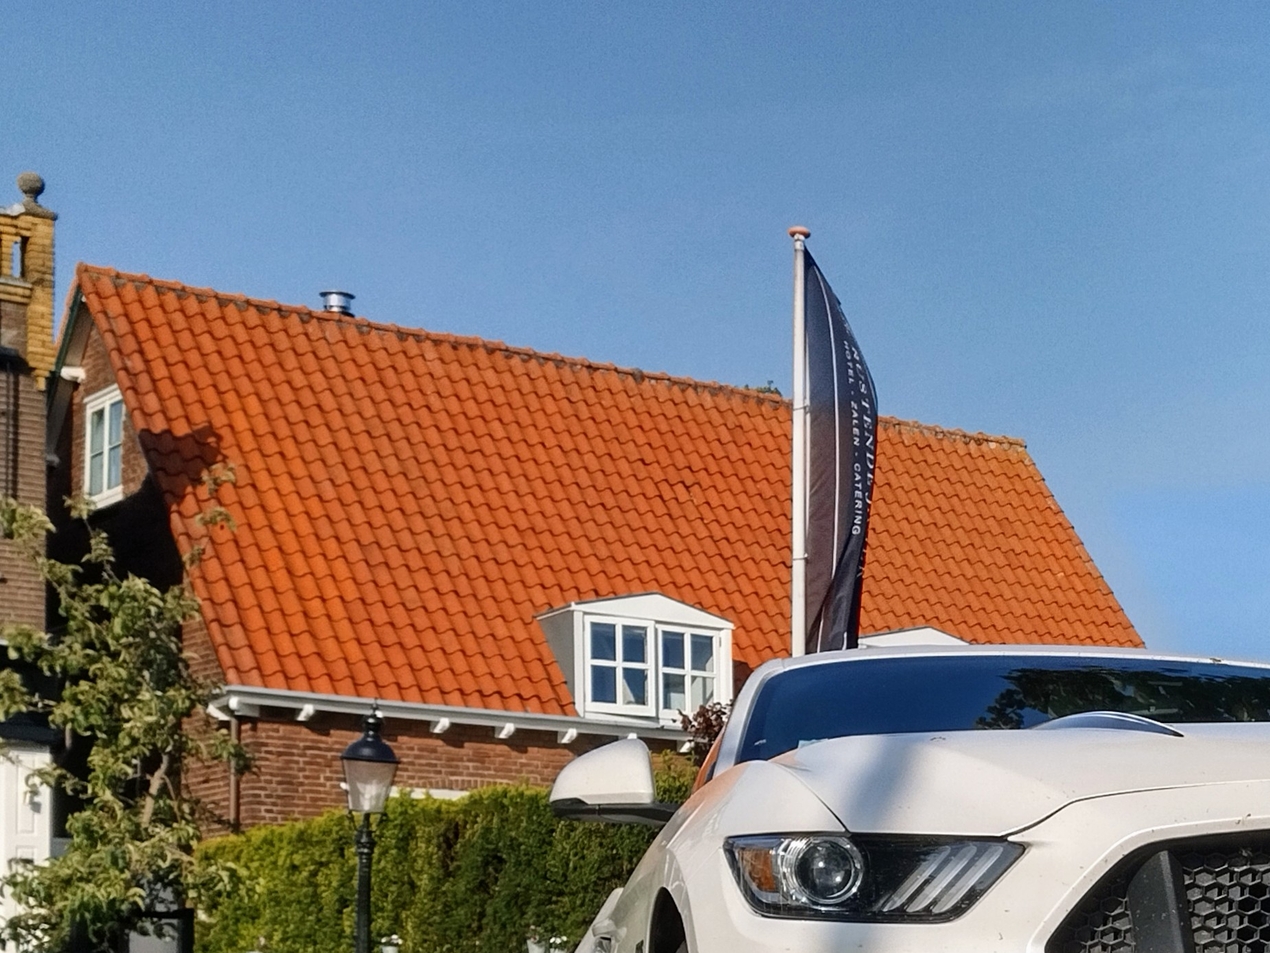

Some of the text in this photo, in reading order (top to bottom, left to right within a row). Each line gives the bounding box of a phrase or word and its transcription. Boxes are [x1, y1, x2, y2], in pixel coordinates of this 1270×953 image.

[843, 340, 855, 384] HOTEL
[850, 401, 860, 446] ZALEN
[851, 463, 863, 535] CATERING
